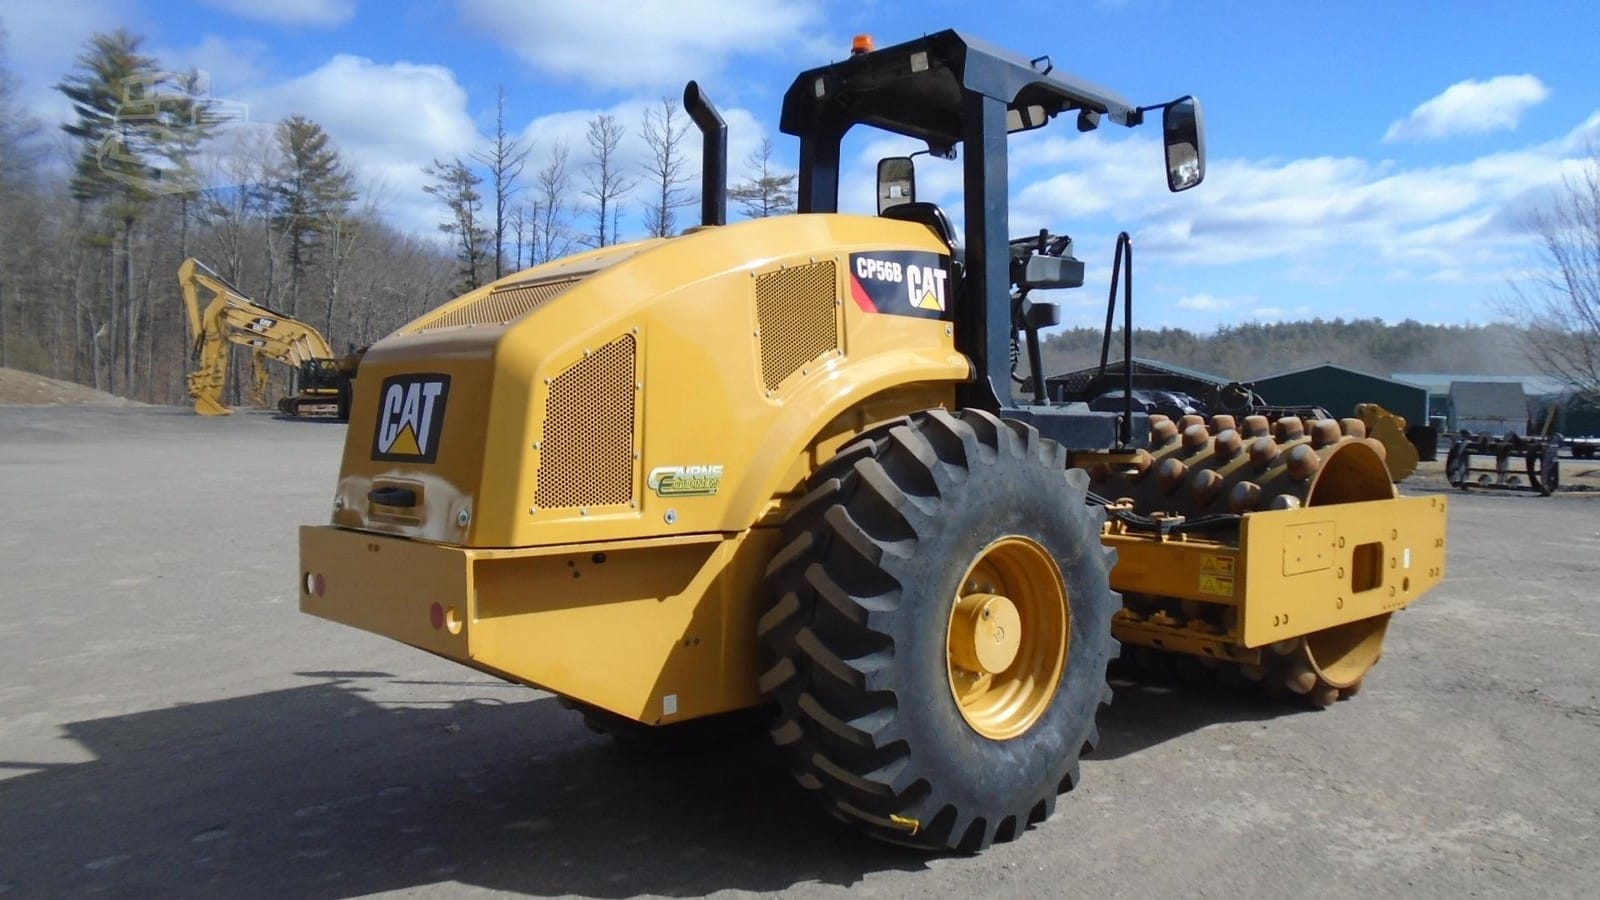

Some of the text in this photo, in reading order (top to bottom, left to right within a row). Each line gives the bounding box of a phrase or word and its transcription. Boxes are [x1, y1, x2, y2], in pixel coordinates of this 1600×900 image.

[856, 257, 947, 312] CP56B CAT
[378, 382, 443, 456] CAT
